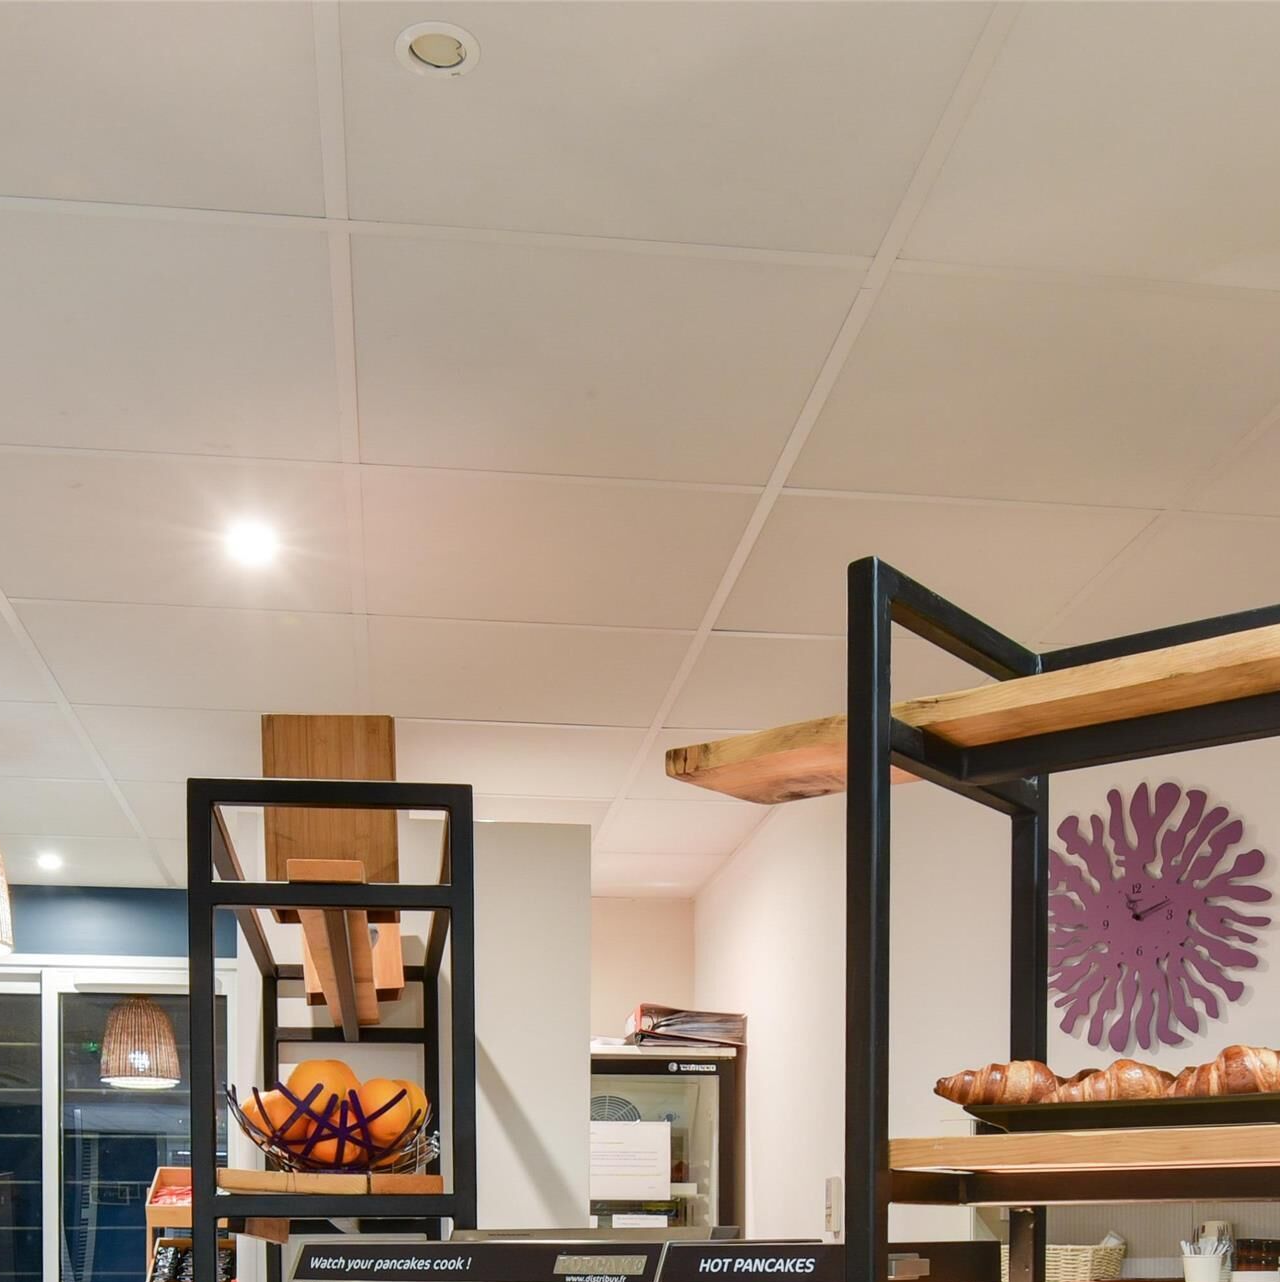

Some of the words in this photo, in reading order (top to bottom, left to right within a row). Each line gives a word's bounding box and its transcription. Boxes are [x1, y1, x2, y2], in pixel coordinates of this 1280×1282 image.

[1132, 883, 1142, 894] 12
[1166, 909, 1173, 920] 3
[1102, 919, 1110, 931] 9
[1136, 946, 1143, 957] 6
[310, 1256, 346, 1270] Watch
[345, 1259, 375, 1272] your
[373, 1256, 432, 1272] pancakes
[433, 1256, 465, 1270] cook
[699, 1258, 733, 1272] HOT
[733, 1258, 816, 1273] PANCAKES
